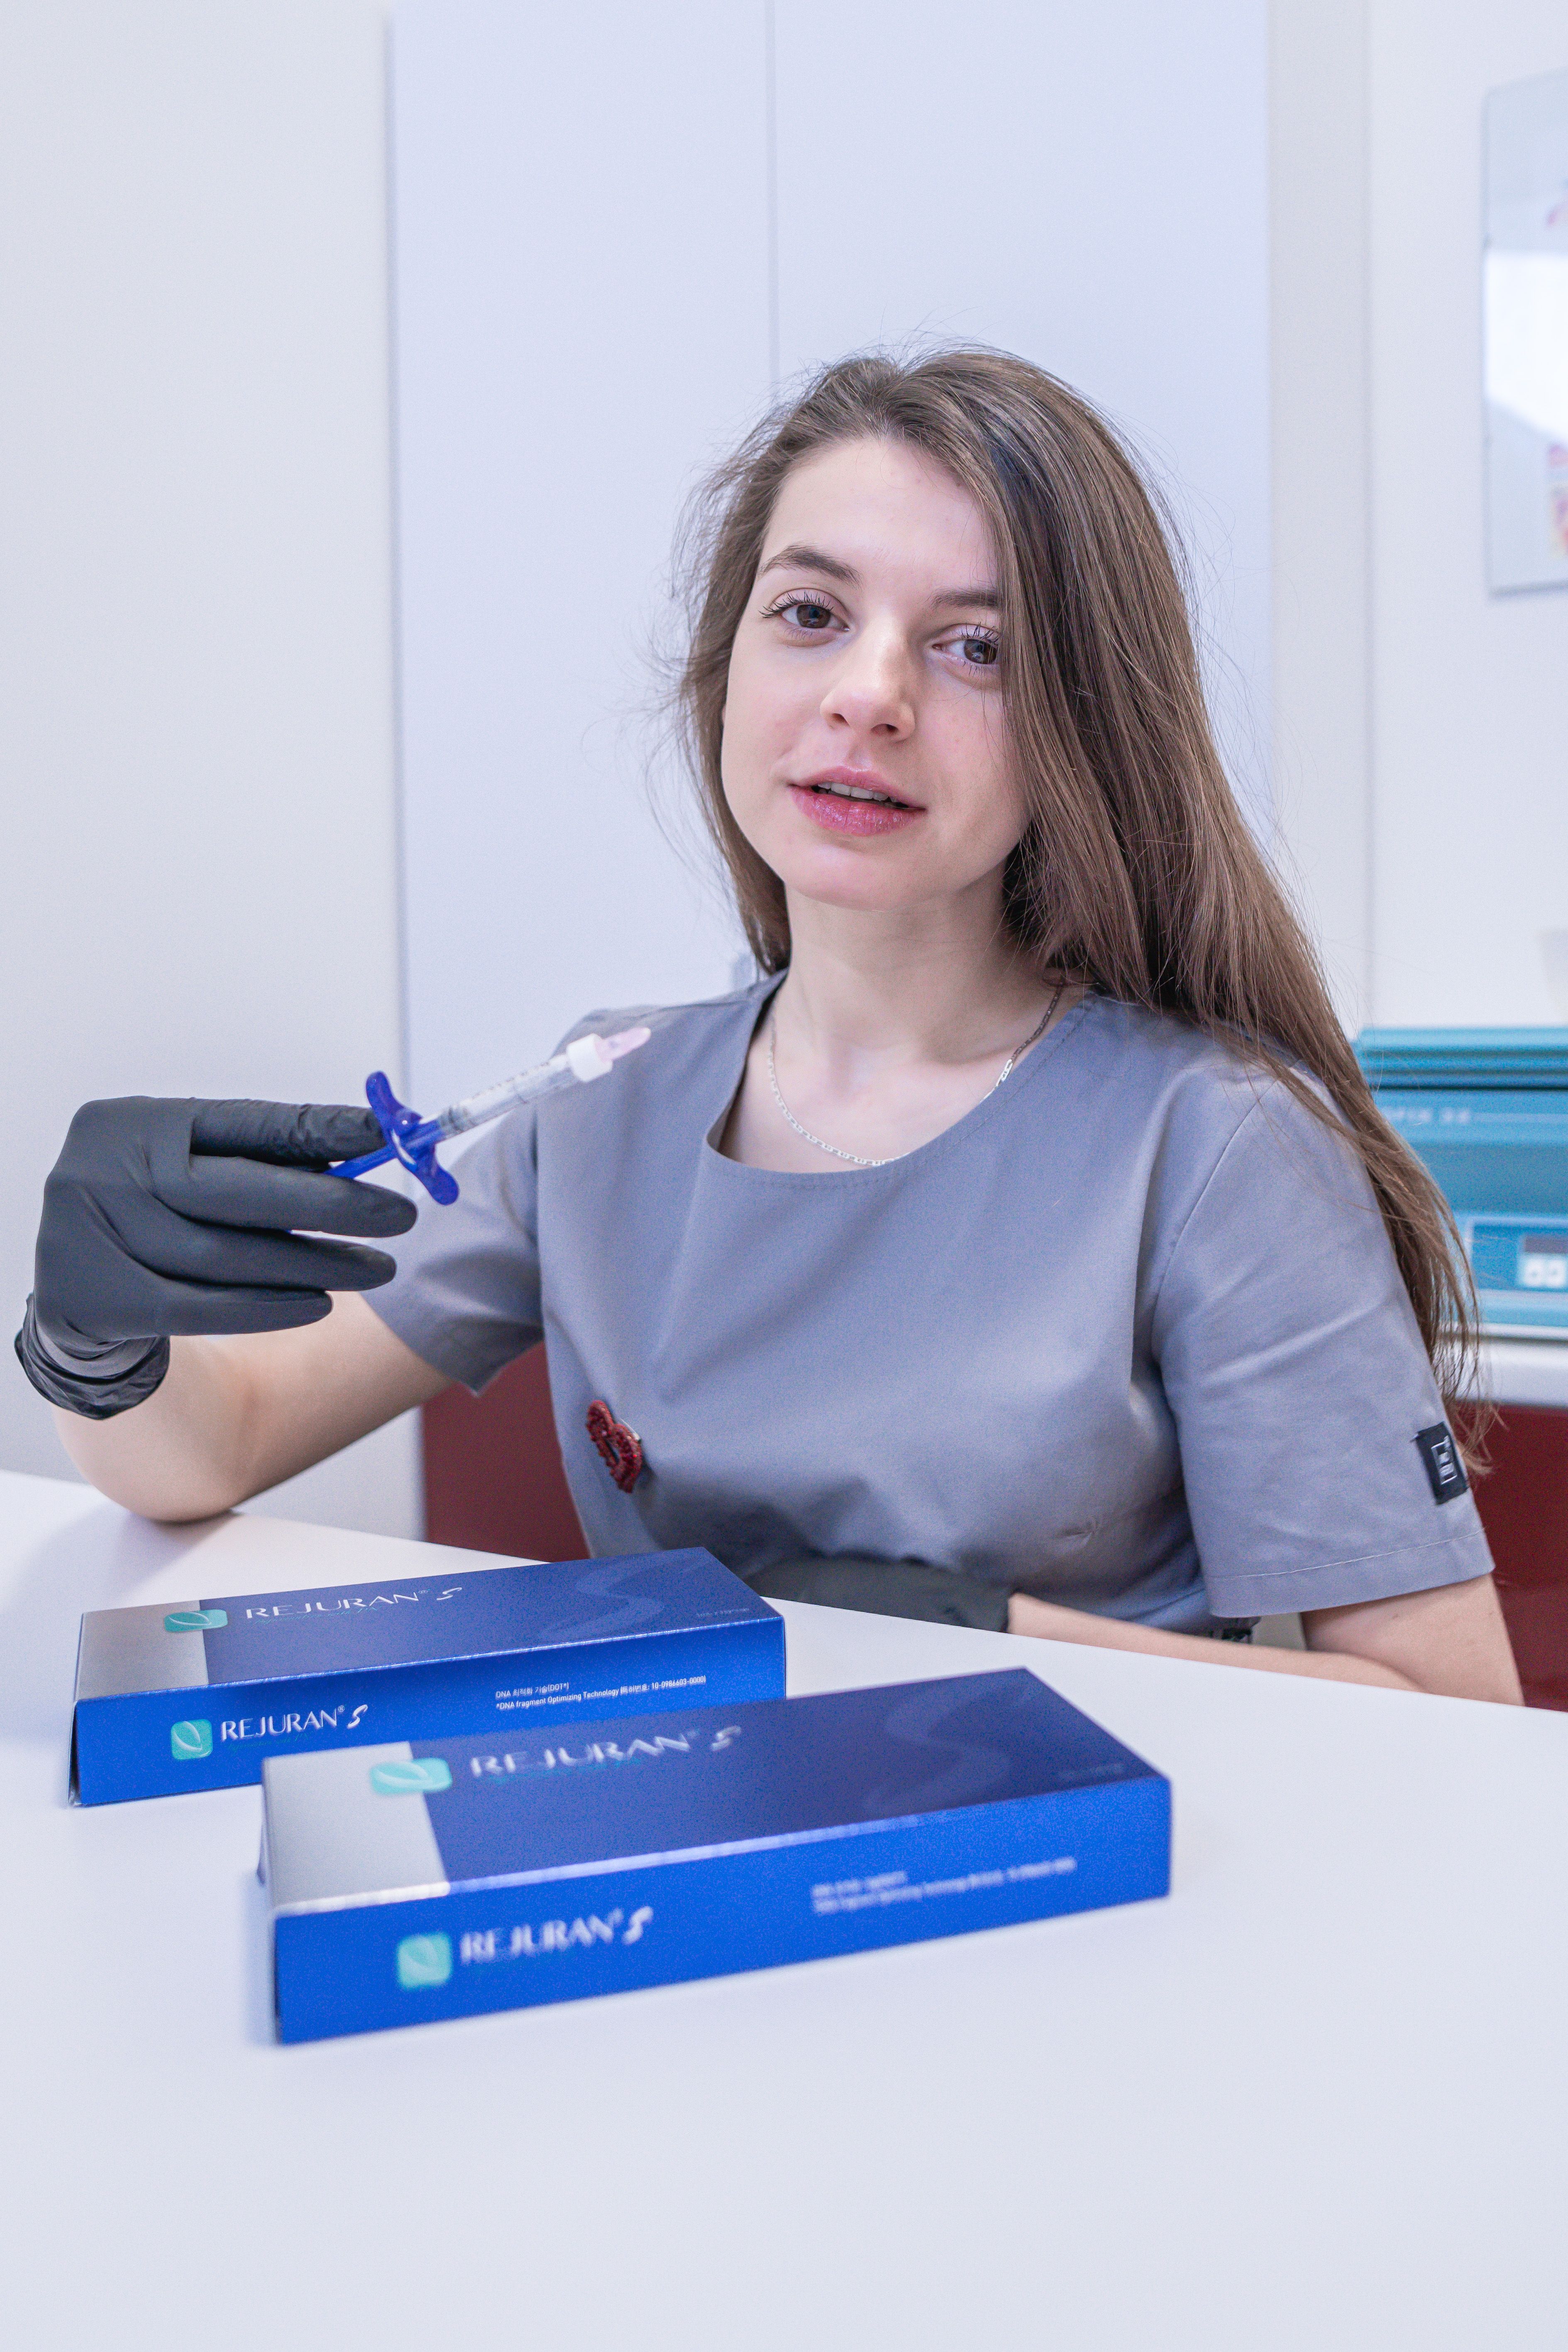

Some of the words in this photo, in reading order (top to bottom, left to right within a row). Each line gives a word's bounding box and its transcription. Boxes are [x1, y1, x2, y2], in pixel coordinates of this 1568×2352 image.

[436, 1587, 462, 1601] S
[513, 1687, 533, 1696] 최적화
[516, 1697, 546, 1709] fragment
[548, 1693, 582, 1703] Optimizing
[583, 1688, 619, 1700] Technology
[652, 1675, 706, 1690] 10-0986603-0000)
[347, 1704, 368, 1729] S
